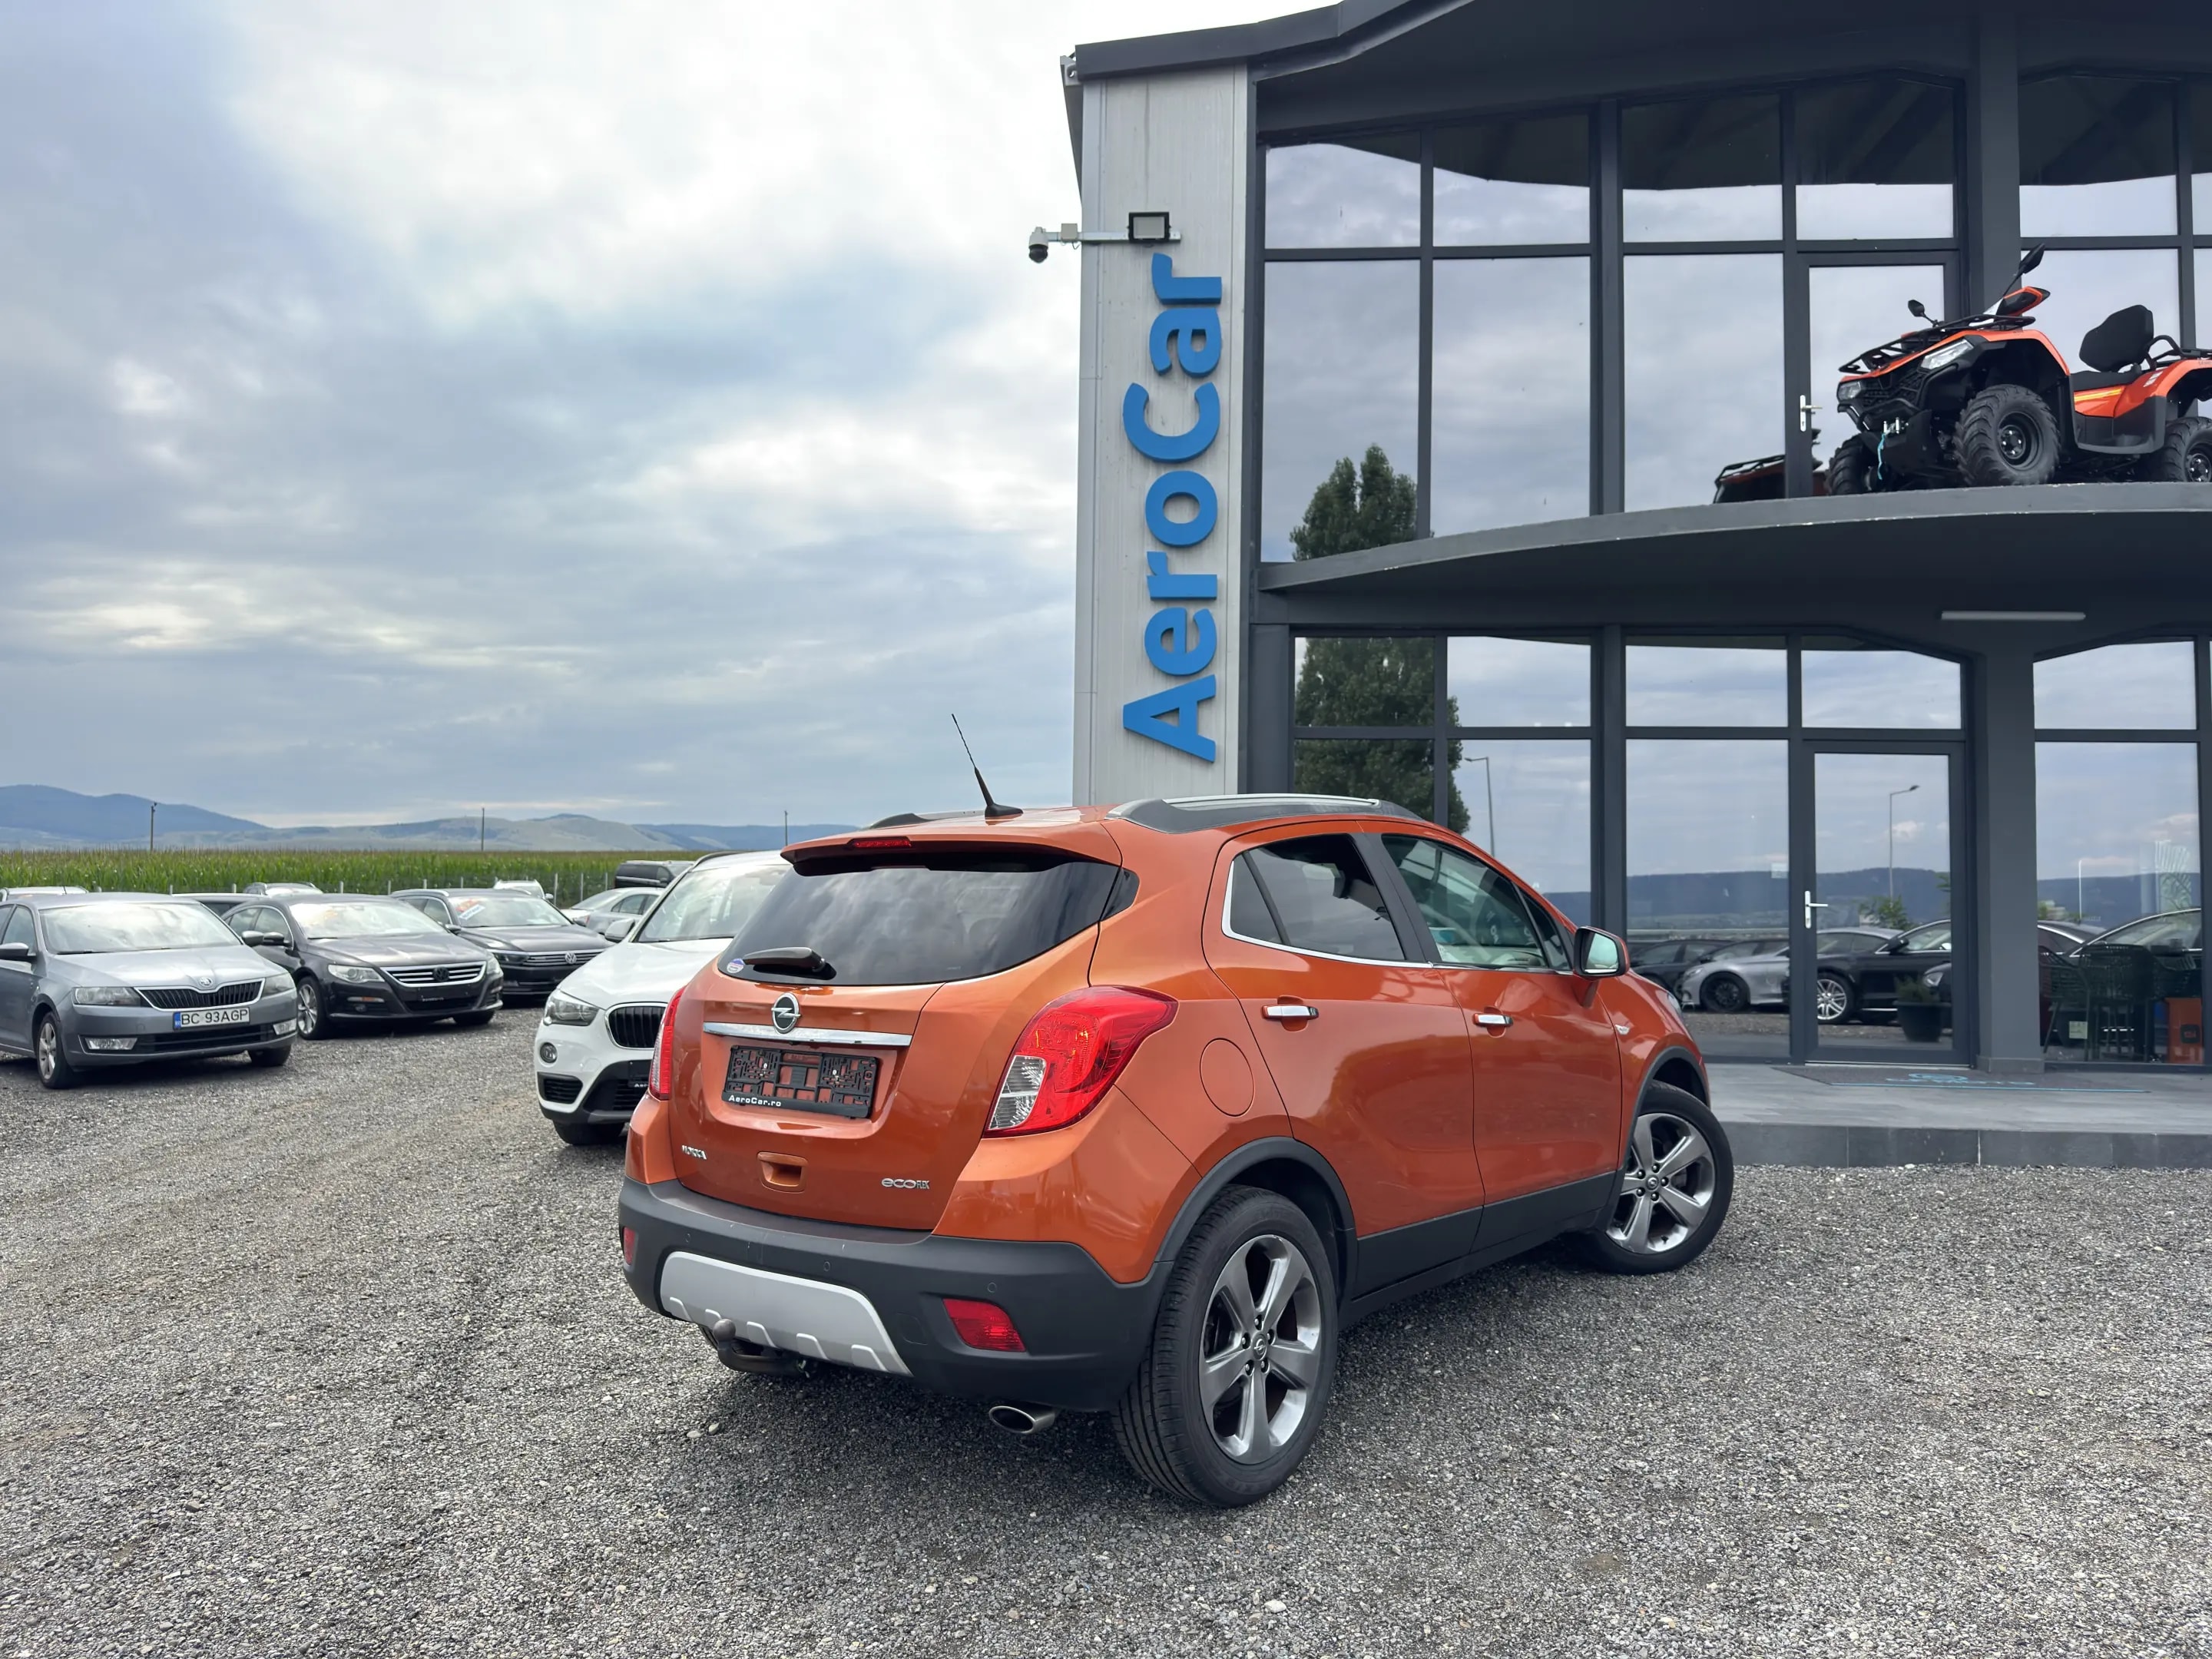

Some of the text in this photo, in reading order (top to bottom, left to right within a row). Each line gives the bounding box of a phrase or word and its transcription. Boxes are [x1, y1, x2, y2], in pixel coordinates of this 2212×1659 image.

[1123, 253, 1222, 763] AeroCar
[181, 1013, 200, 1025] BC
[204, 1009, 248, 1023] 93AGP
[728, 1094, 781, 1107] AeroCar.ro
